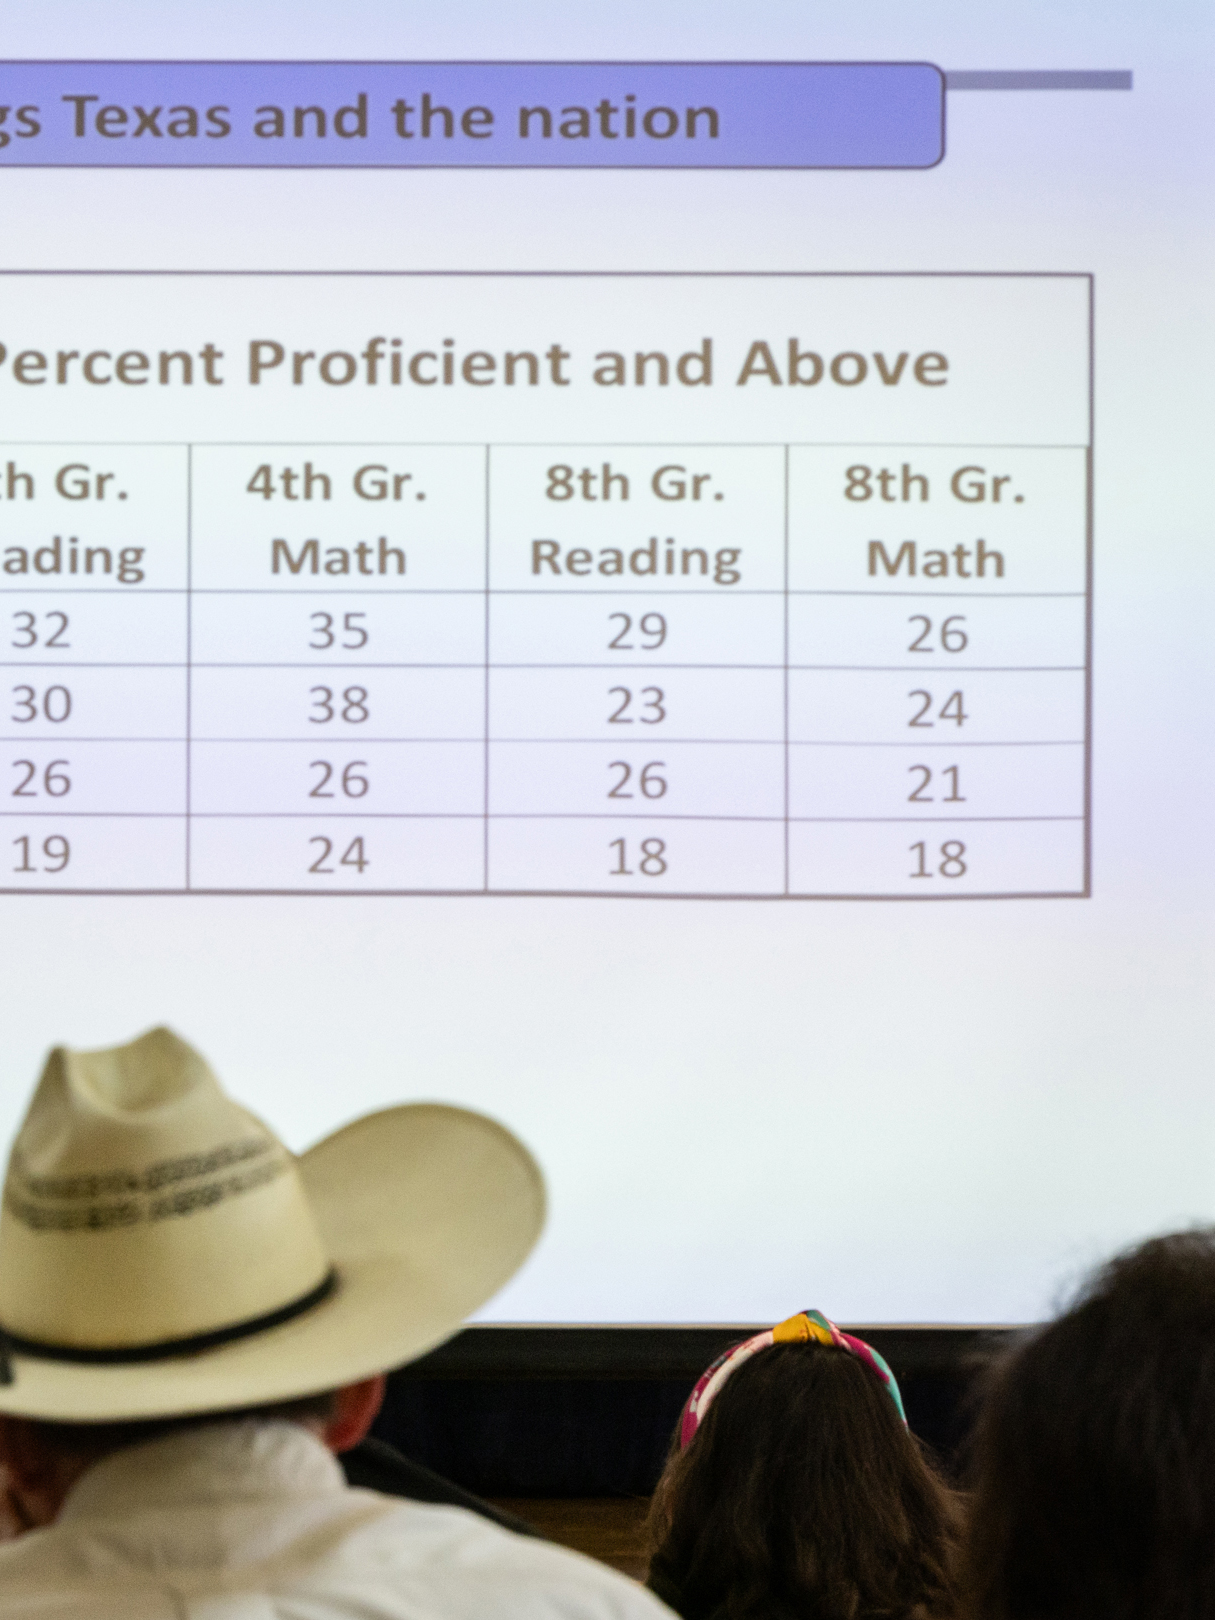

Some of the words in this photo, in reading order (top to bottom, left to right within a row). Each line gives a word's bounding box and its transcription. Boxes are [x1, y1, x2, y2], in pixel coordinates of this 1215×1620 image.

[61, 94, 232, 139] Texas
[253, 91, 368, 140] and
[390, 92, 495, 140] the
[518, 93, 720, 140] nation
[248, 335, 571, 387] Proficient
[592, 337, 713, 387] and
[736, 337, 950, 388] Above
[54, 462, 128, 502] Gr.
[246, 461, 332, 501] 4th
[352, 463, 426, 502] Gr.
[545, 462, 630, 502] 8th
[650, 464, 724, 502] Gr.
[843, 462, 930, 503] 8th
[949, 464, 1025, 504] Gr.
[271, 535, 407, 576] Math
[531, 536, 742, 586] Reading
[867, 538, 1005, 579] Math
[11, 610, 70, 650] 32
[309, 610, 370, 651] 35
[607, 611, 668, 651] 29
[907, 613, 970, 654] 26
[11, 684, 73, 724] 30
[308, 684, 371, 725] 38
[607, 685, 667, 726] 23
[907, 688, 969, 729] 24
[11, 758, 72, 798] 26
[308, 759, 370, 799] 26
[606, 760, 669, 800] 26
[907, 763, 966, 803] 21
[13, 834, 72, 874] 19
[307, 835, 370, 874] 24
[609, 836, 669, 878] 18
[909, 839, 968, 879] 18
